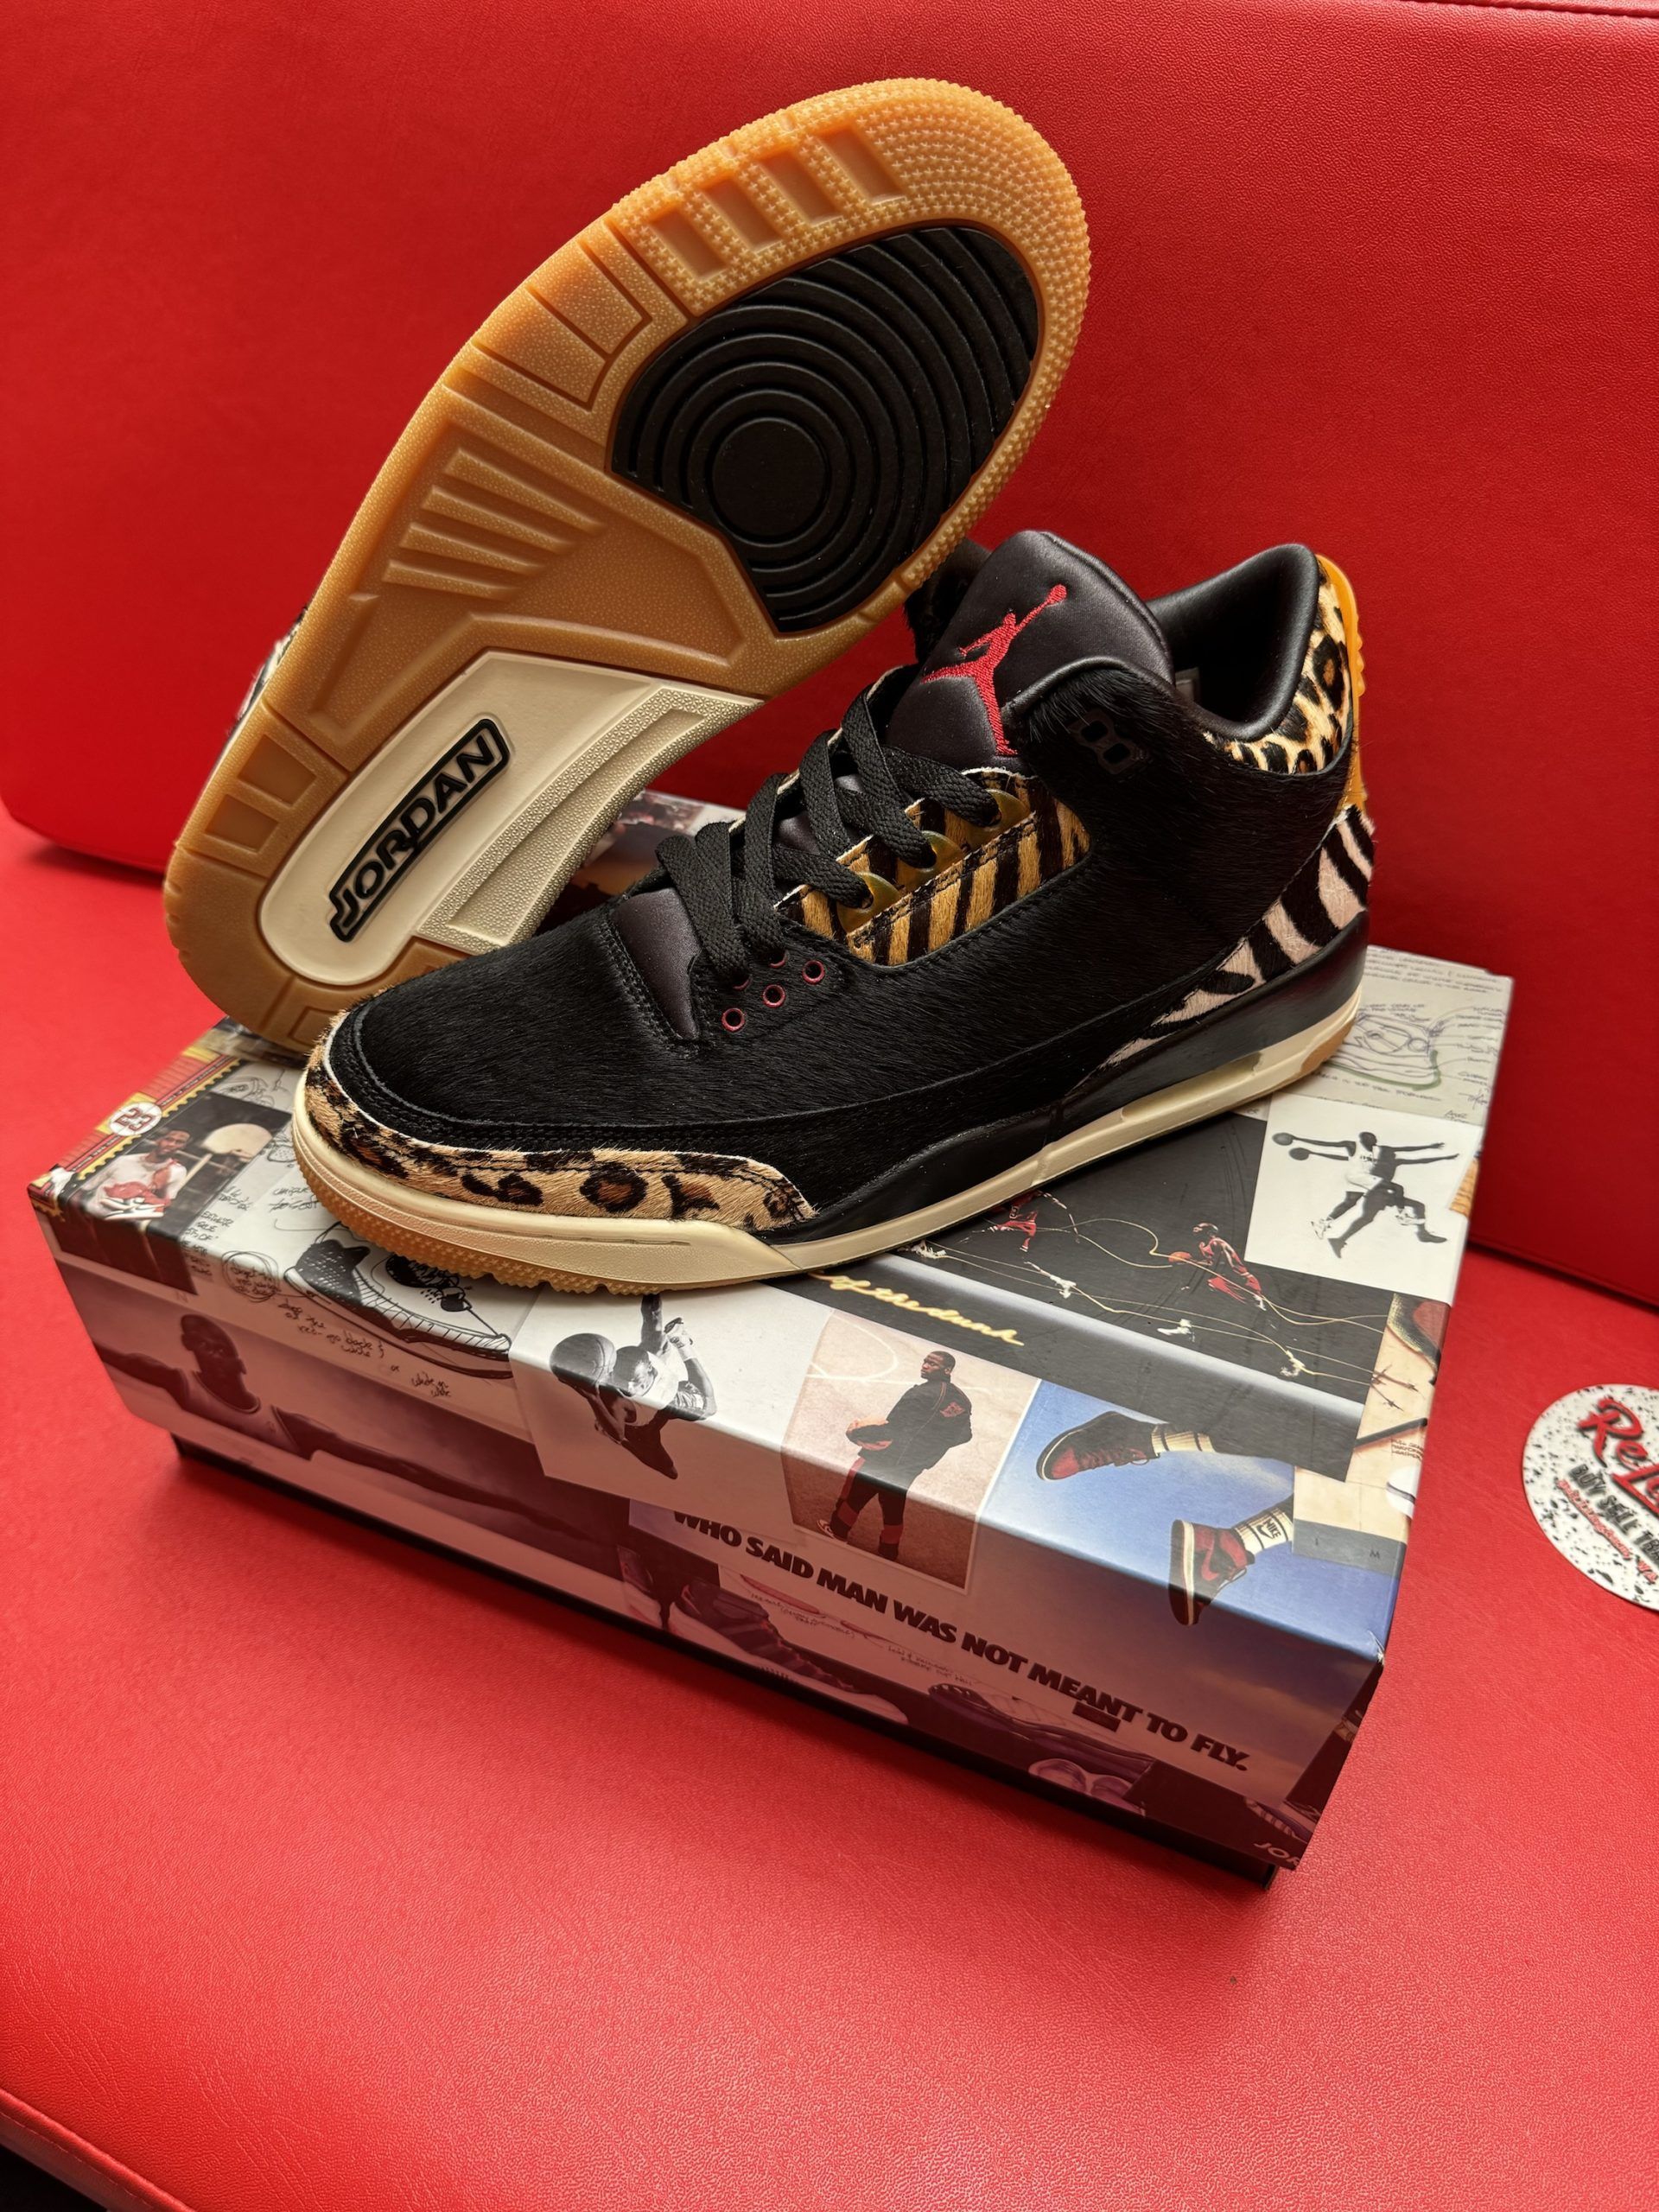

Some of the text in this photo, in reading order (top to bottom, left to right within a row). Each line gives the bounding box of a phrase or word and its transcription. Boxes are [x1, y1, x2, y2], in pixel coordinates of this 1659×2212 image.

[342, 734, 495, 927] JORDAN
[115, 1107, 157, 1132] 23
[873, 1287, 920, 1308] the
[1569, 1463, 1609, 1497] BUY
[1599, 1494, 1638, 1536] SELL
[1263, 1517, 1281, 1539] NIKE
[674, 1510, 742, 1548] WHO
[746, 1536, 815, 1580] SAID
[816, 1567, 889, 1614] MAN
[893, 1599, 957, 1643] WAS
[961, 1632, 1028, 1674] NOT
[1027, 1662, 1144, 1724] MEANT
[1146, 1712, 1189, 1743] TO
[1190, 1733, 1251, 1772] FLY.
